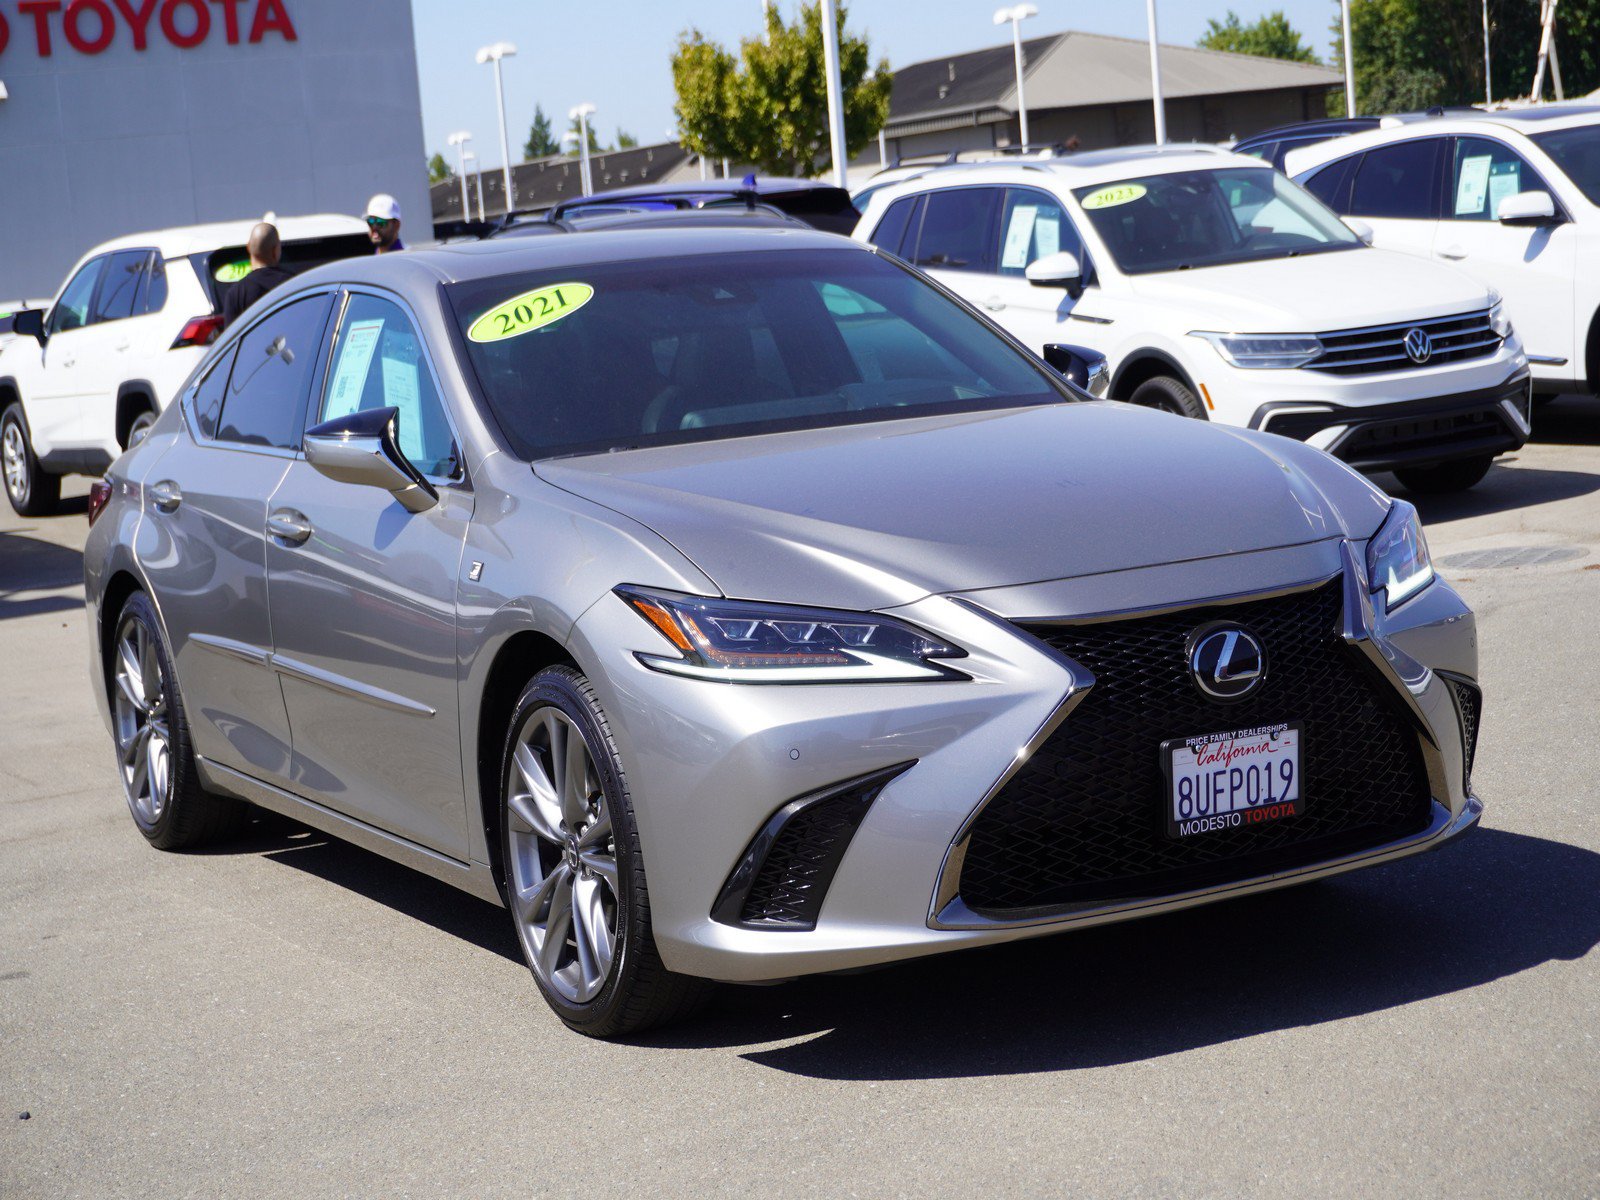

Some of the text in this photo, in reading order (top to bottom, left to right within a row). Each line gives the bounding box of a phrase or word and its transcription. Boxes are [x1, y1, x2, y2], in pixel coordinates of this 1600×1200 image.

[18, 0, 298, 58] TOYOTA
[494, 289, 568, 335] 2021
[1186, 723, 1288, 747] PRICE FAMILY DEALERSHIPS
[1197, 740, 1278, 768] California
[1178, 758, 1294, 819] 8UFP019
[1180, 803, 1296, 837] MODESTO TOYOTA
